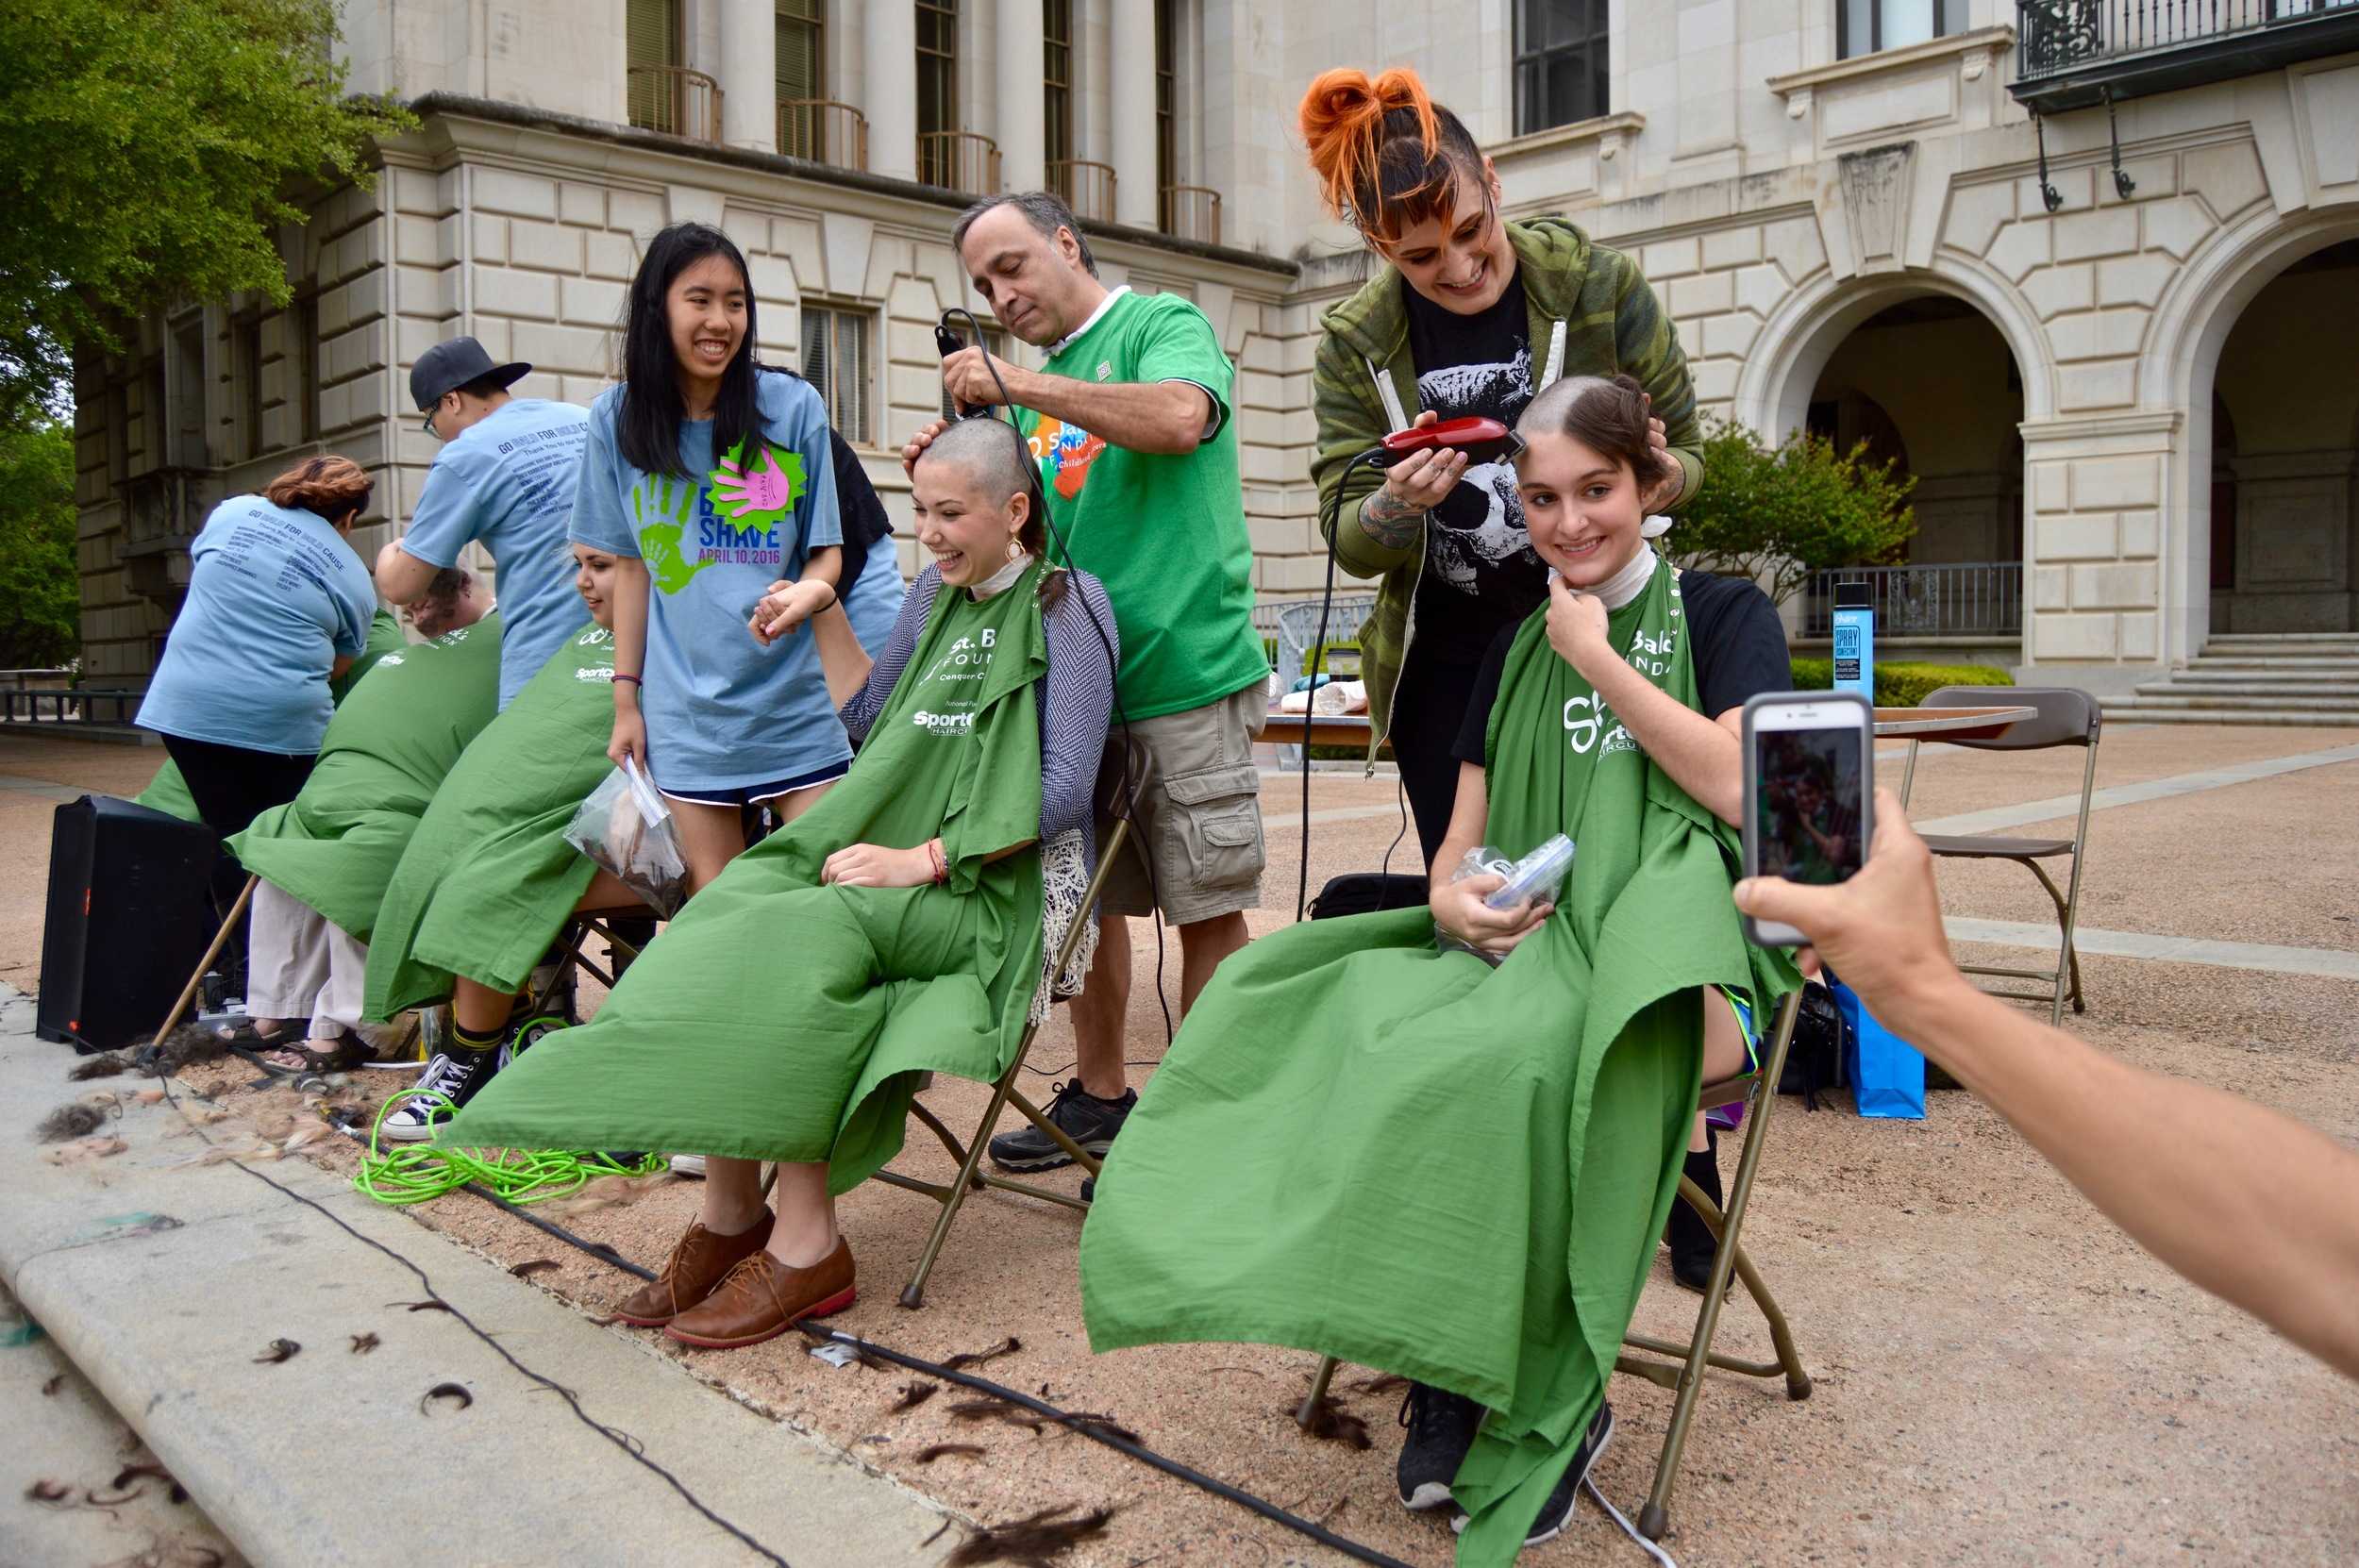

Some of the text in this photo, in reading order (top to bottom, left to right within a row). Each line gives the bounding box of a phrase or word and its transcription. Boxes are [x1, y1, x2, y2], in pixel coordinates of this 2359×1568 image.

[498, 442, 514, 455] GO
[537, 428, 559, 441] FOR
[248, 509, 262, 519] GO
[284, 523, 303, 537] FOR
[322, 547, 345, 573] CAUSE
[698, 549, 780, 564] APRIL 10, 2016
[1835, 629, 1858, 647] SPRAY
[939, 672, 976, 681] Conquer
